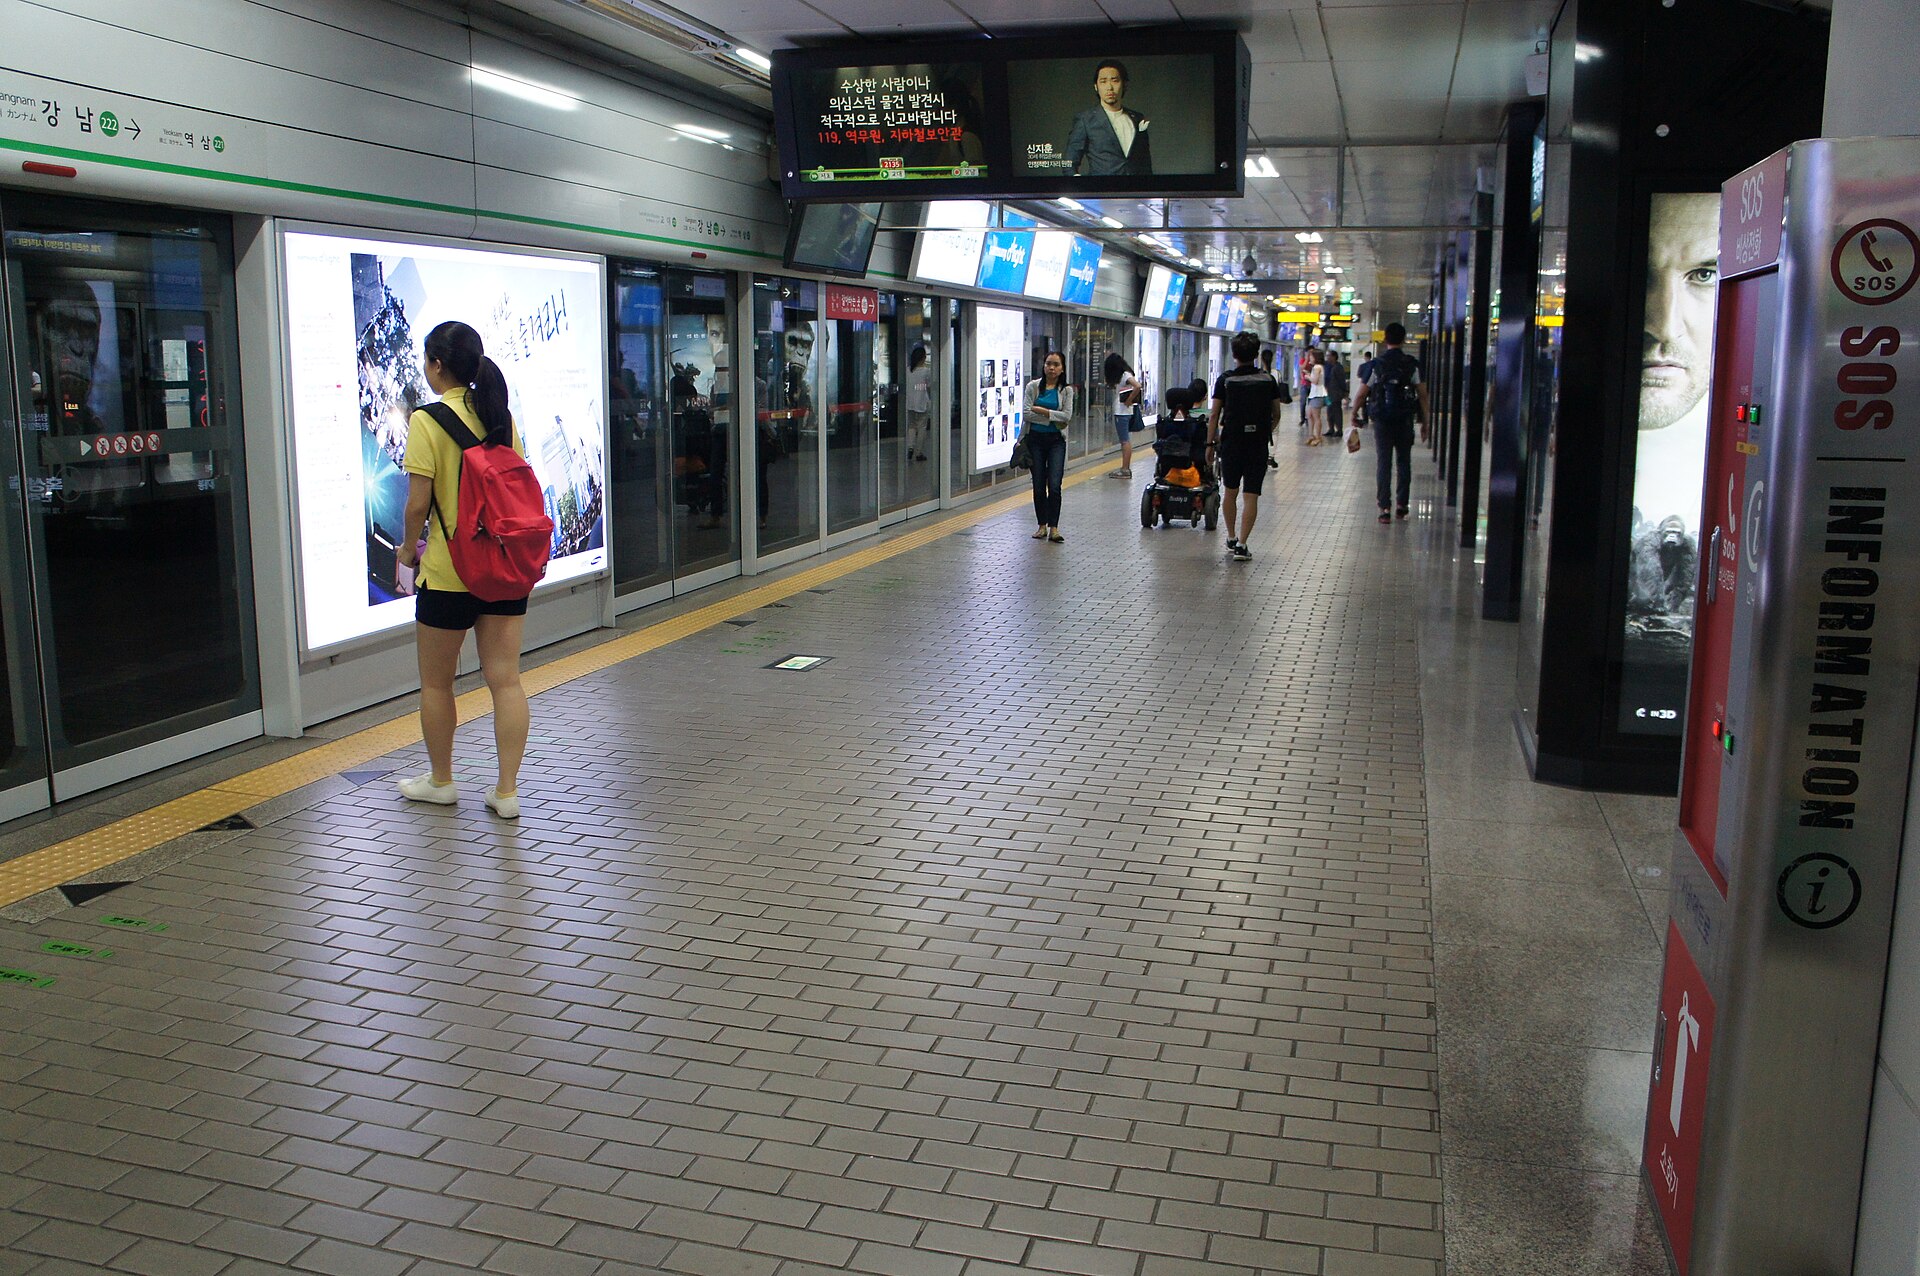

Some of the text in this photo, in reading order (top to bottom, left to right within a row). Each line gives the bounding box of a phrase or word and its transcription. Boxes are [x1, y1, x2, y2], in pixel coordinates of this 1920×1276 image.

[840, 75, 931, 94] 수상한 사람이나
[829, 92, 945, 111] 의심스런 물건 발견시
[100, 117, 118, 131] 222
[820, 109, 957, 129] 적극적으로 신고바랍니다
[818, 126, 963, 145] 119, 역무원, 지하철보안관
[1026, 143, 1053, 154] 신지훈
[1741, 171, 1764, 224] SOS
[1736, 227, 1762, 264] 비상전화
[1854, 276, 1896, 291] SOS
[1722, 538, 1736, 561] SOS
[1799, 326, 1900, 829] SOS INFORMATION
